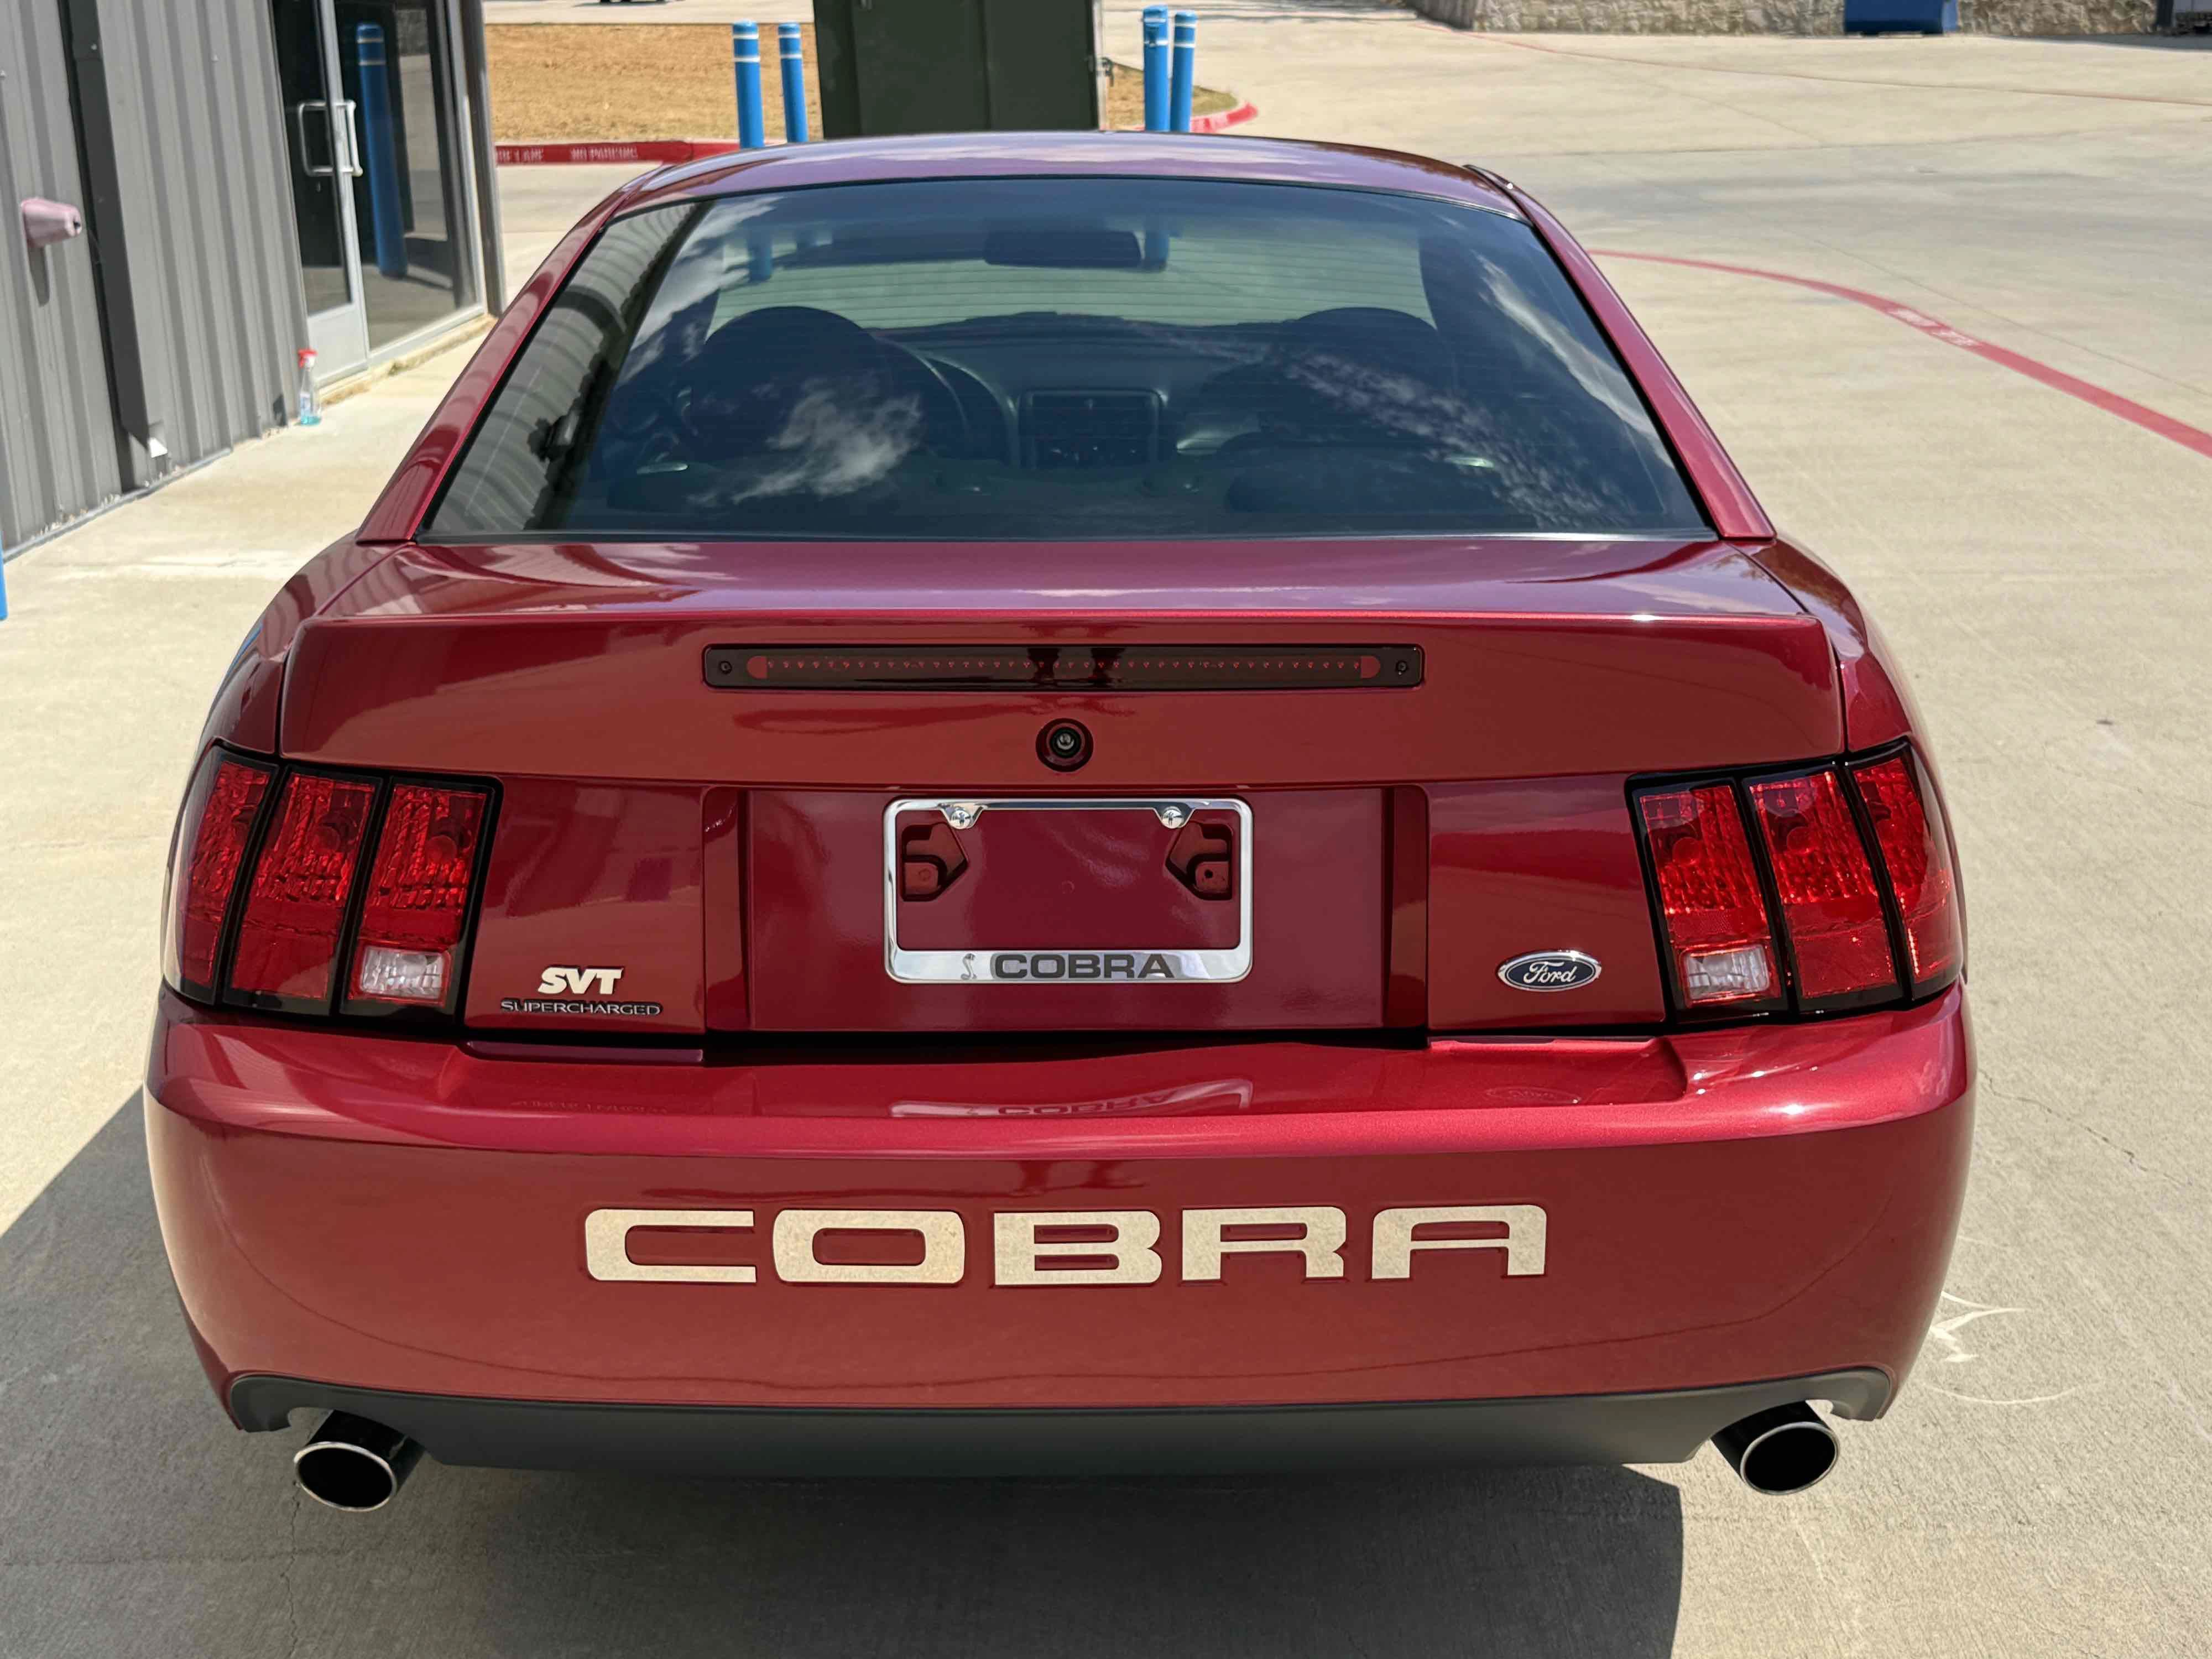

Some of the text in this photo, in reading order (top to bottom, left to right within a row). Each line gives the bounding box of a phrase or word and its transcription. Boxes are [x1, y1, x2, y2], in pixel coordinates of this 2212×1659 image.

[995, 953, 1175, 979] COBRA
[1523, 961, 1577, 984] Ford
[537, 967, 624, 994] SVT
[500, 1000, 661, 1015] SUPERCHARGED
[585, 1204, 1547, 1286] COBRA
